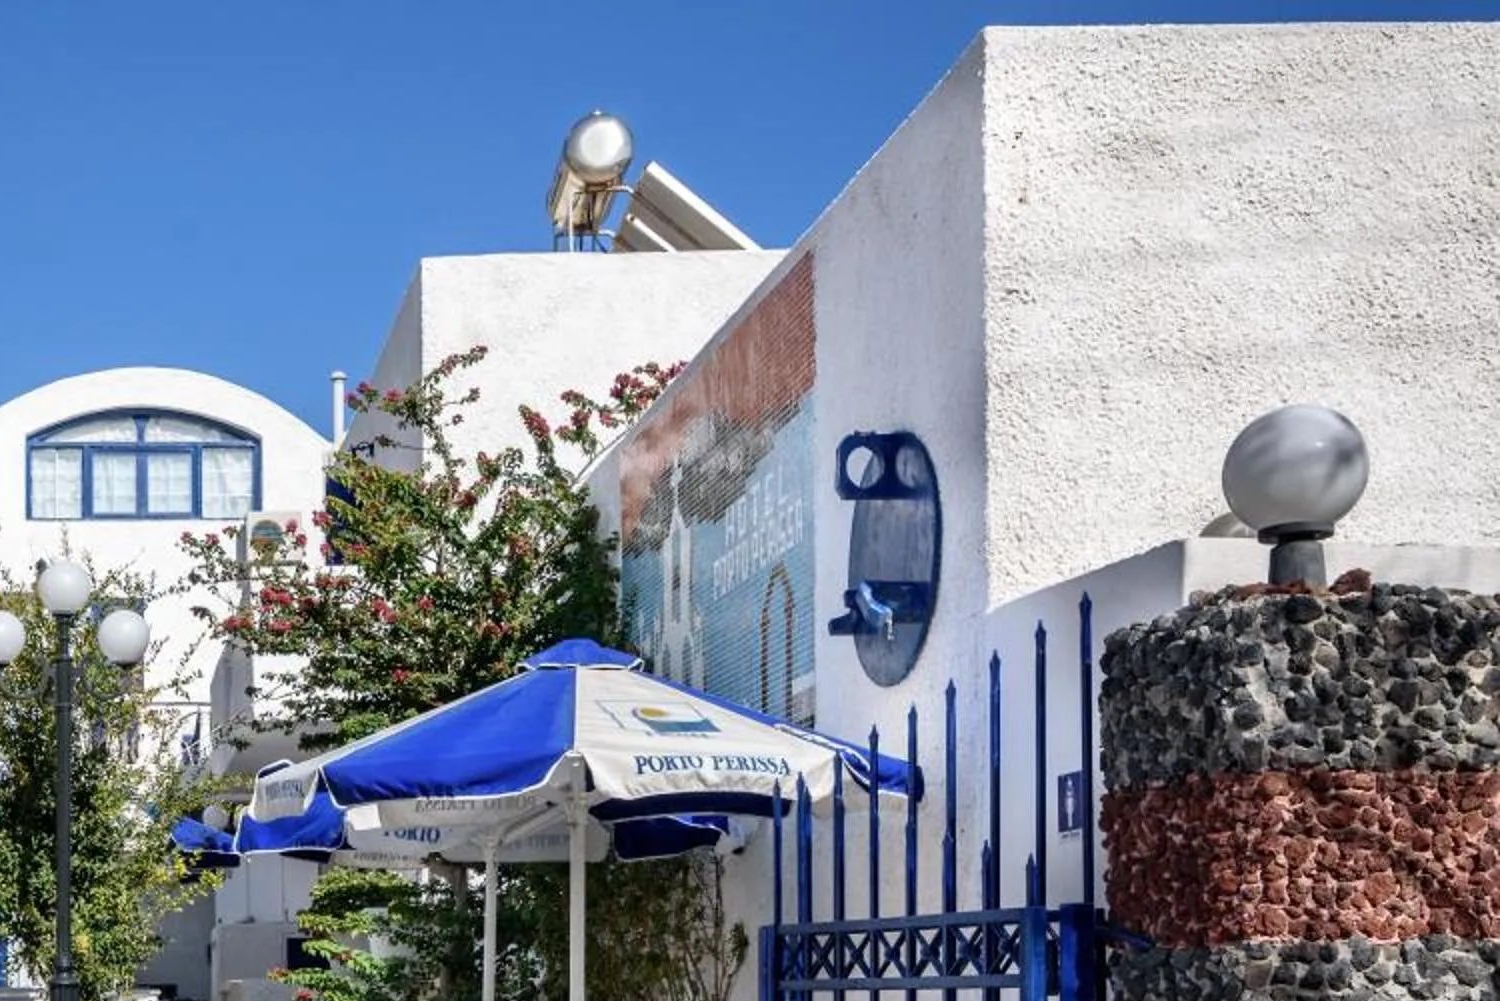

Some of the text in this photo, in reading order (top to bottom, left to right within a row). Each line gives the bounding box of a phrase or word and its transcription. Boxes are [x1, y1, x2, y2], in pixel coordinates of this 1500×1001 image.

[725, 464, 787, 547] HOTEL
[634, 755, 791, 776] PORTO PERISSA
[383, 826, 441, 845] ORTO
